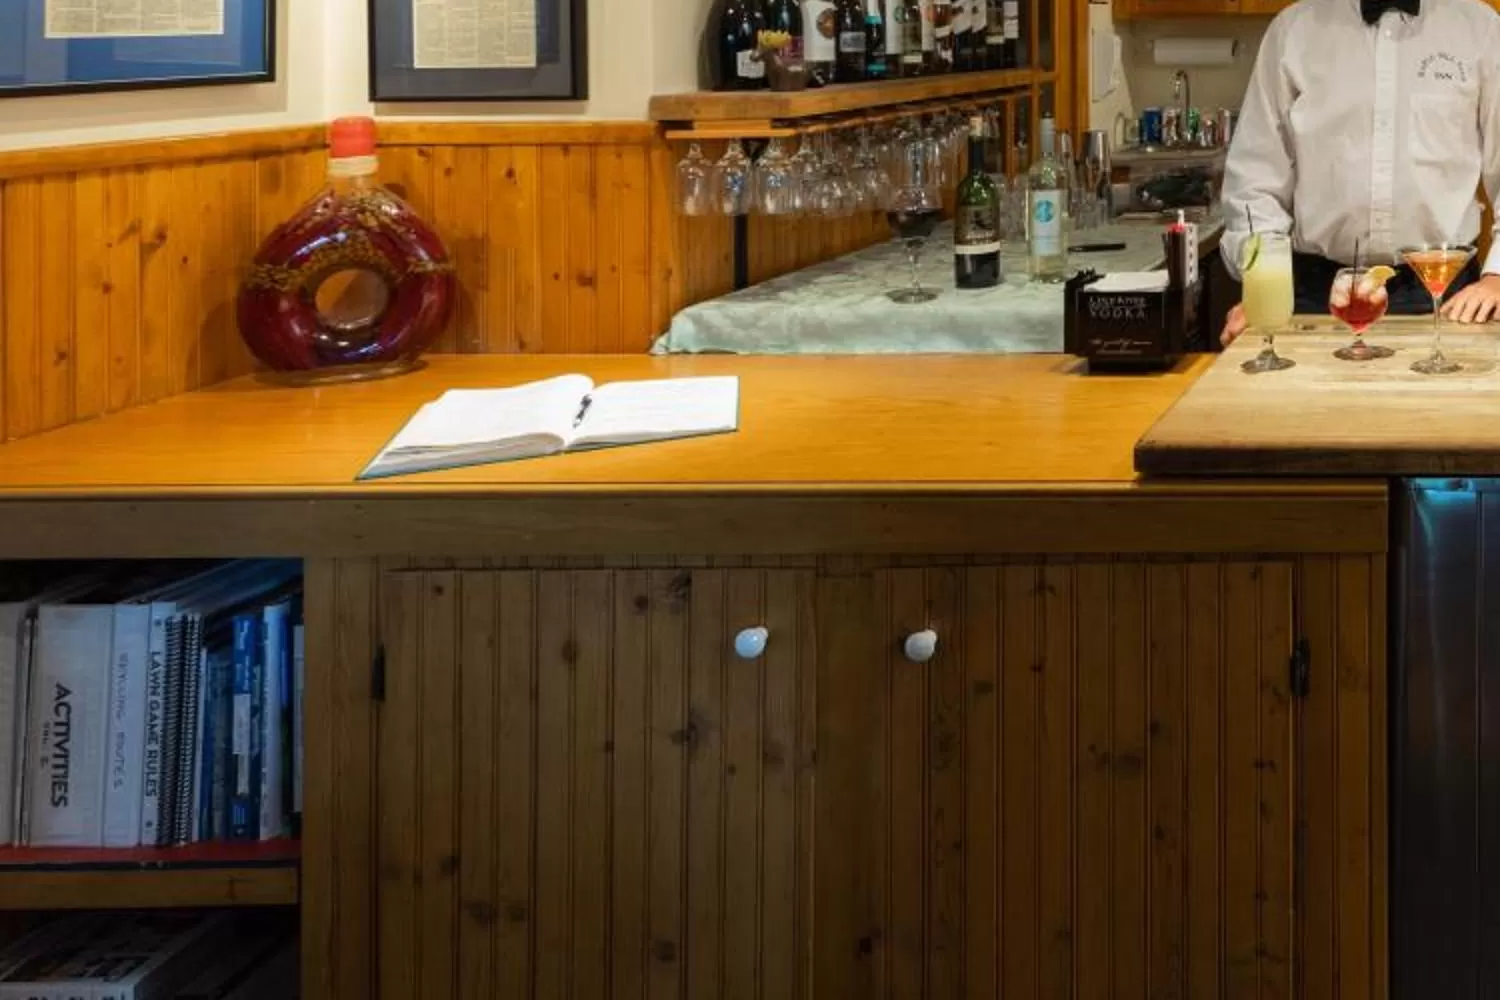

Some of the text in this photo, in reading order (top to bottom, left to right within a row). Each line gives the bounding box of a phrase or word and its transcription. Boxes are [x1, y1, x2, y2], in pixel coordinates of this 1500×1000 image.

[50, 682, 73, 809] ACTIVITIES
[145, 651, 161, 798] LAWN GAME RULES
